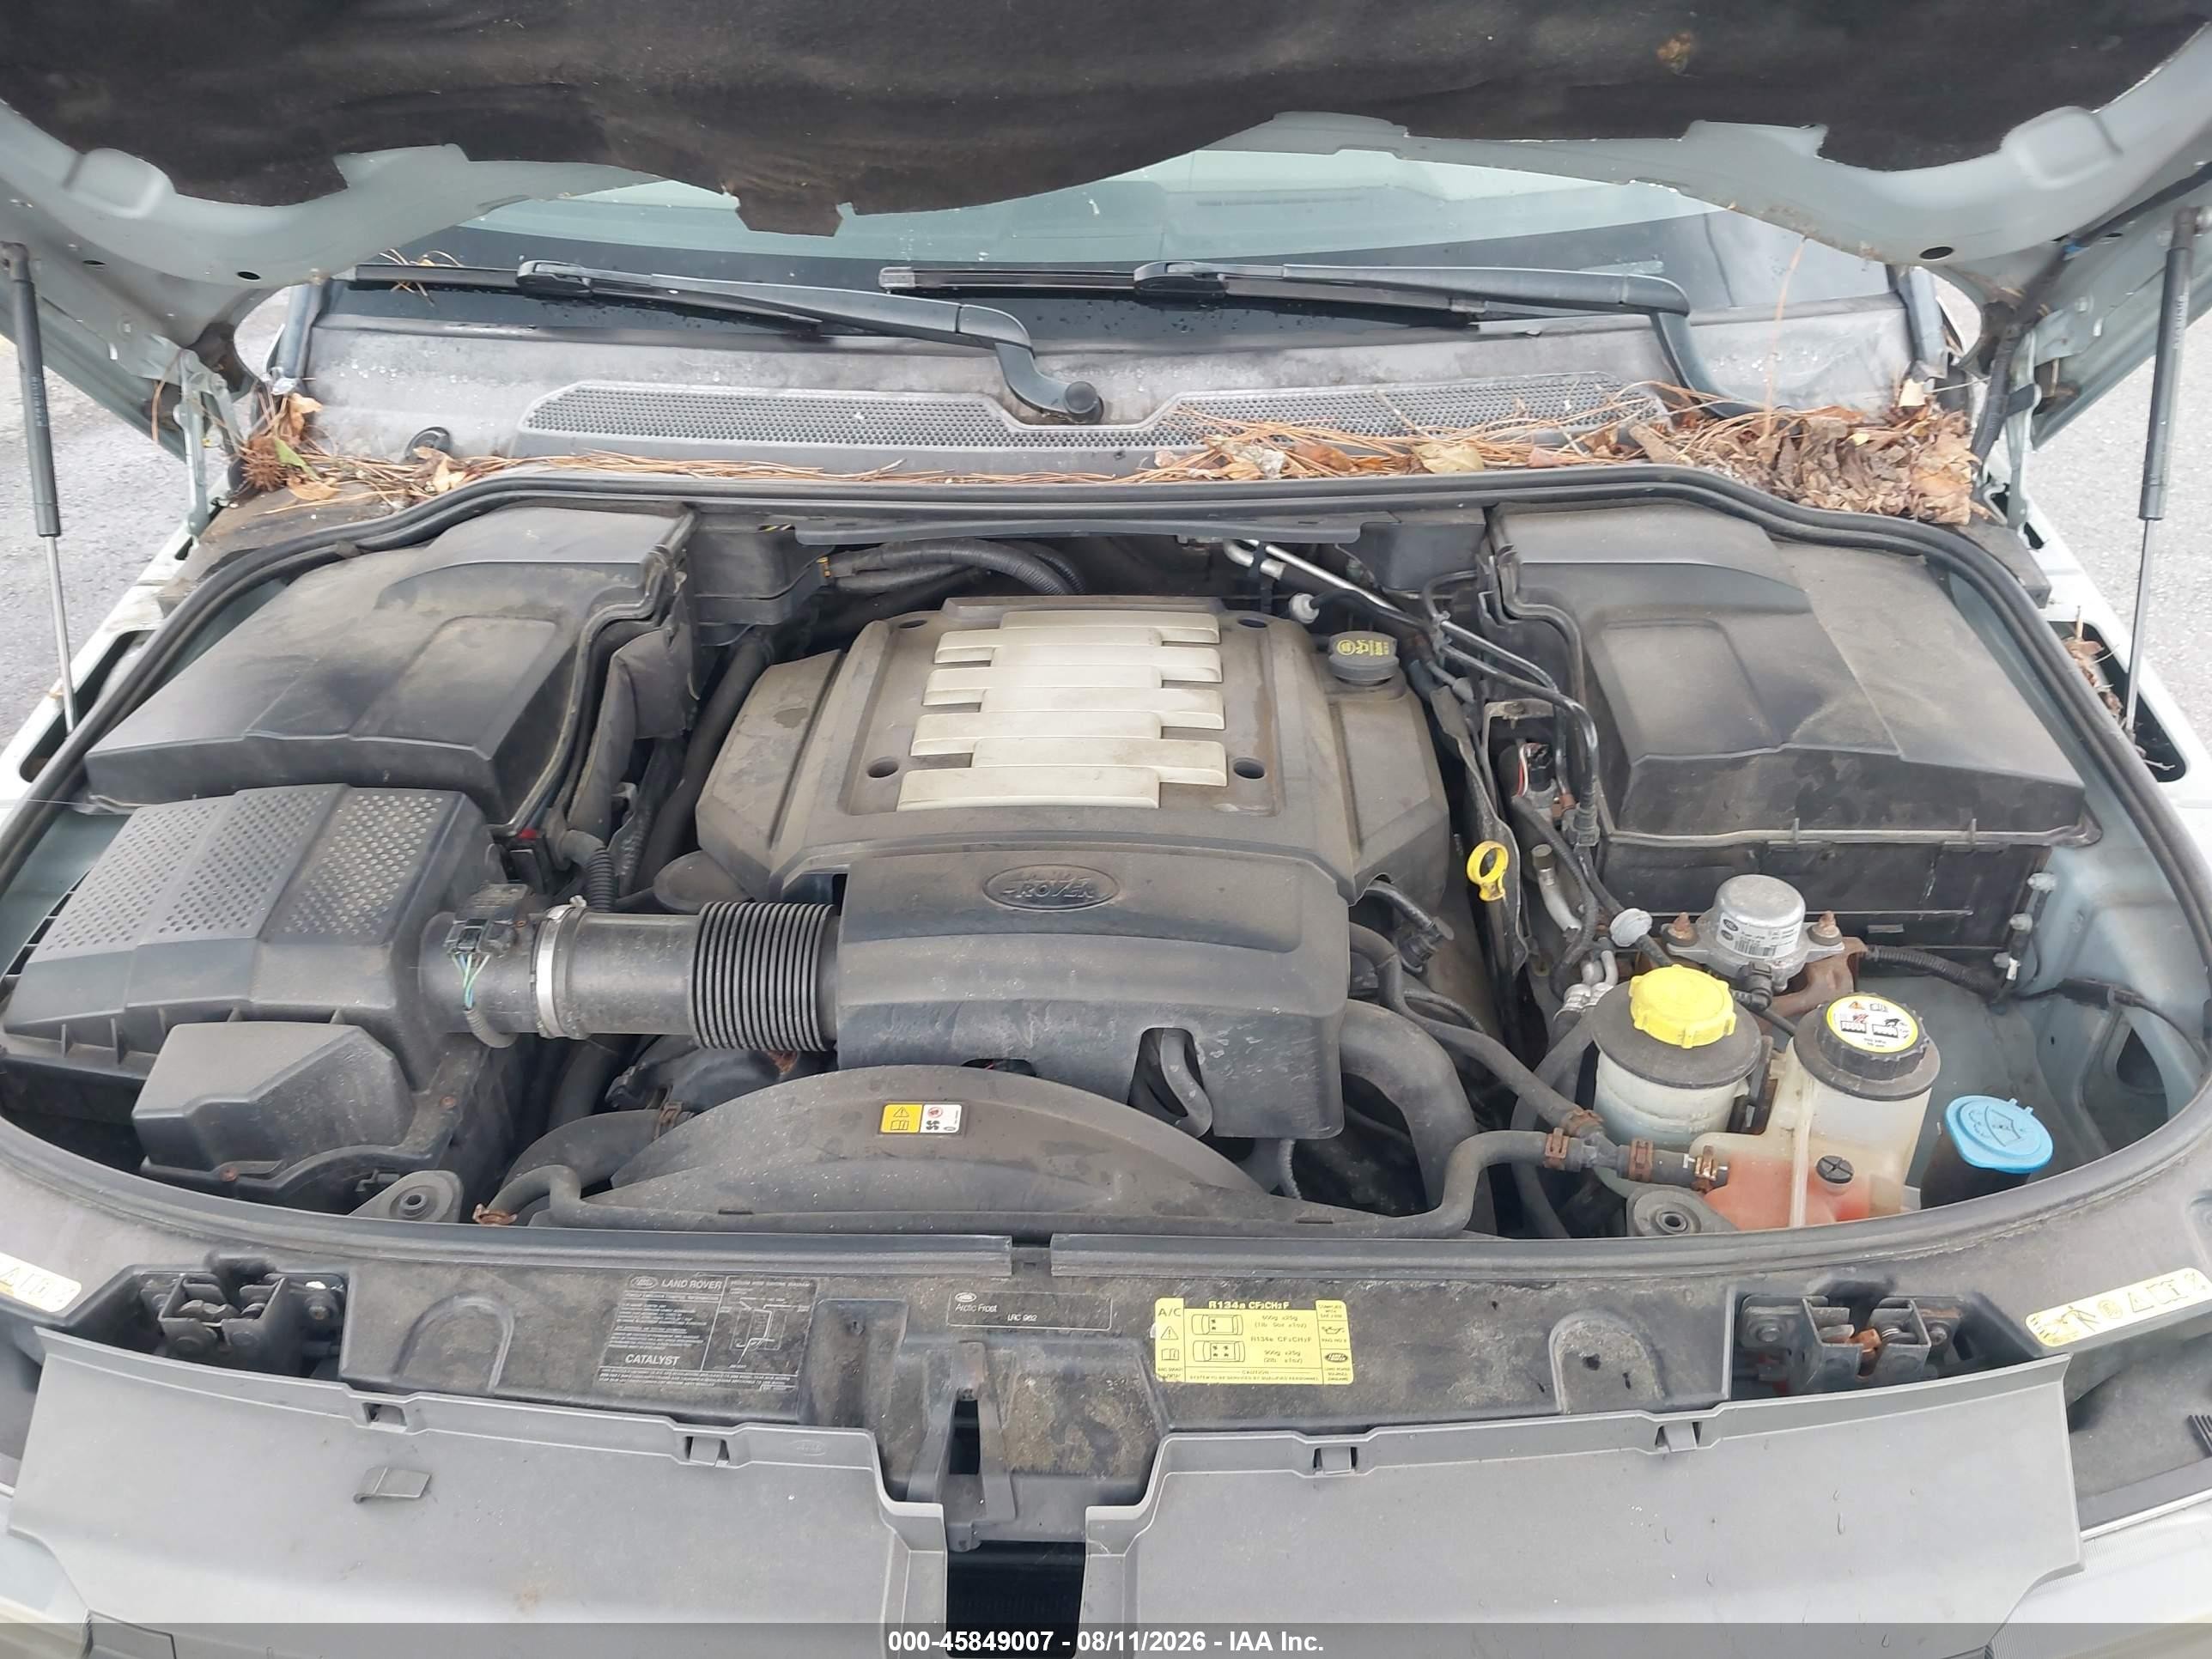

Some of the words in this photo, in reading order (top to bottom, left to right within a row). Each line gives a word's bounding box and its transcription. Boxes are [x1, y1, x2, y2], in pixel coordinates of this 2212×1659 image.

[660, 1279, 688, 1288] LAND
[689, 1279, 722, 1291] ROVER
[978, 1303, 998, 1313] Frost
[1158, 1308, 1182, 1316] A/C
[625, 1353, 681, 1366] CATALYST
